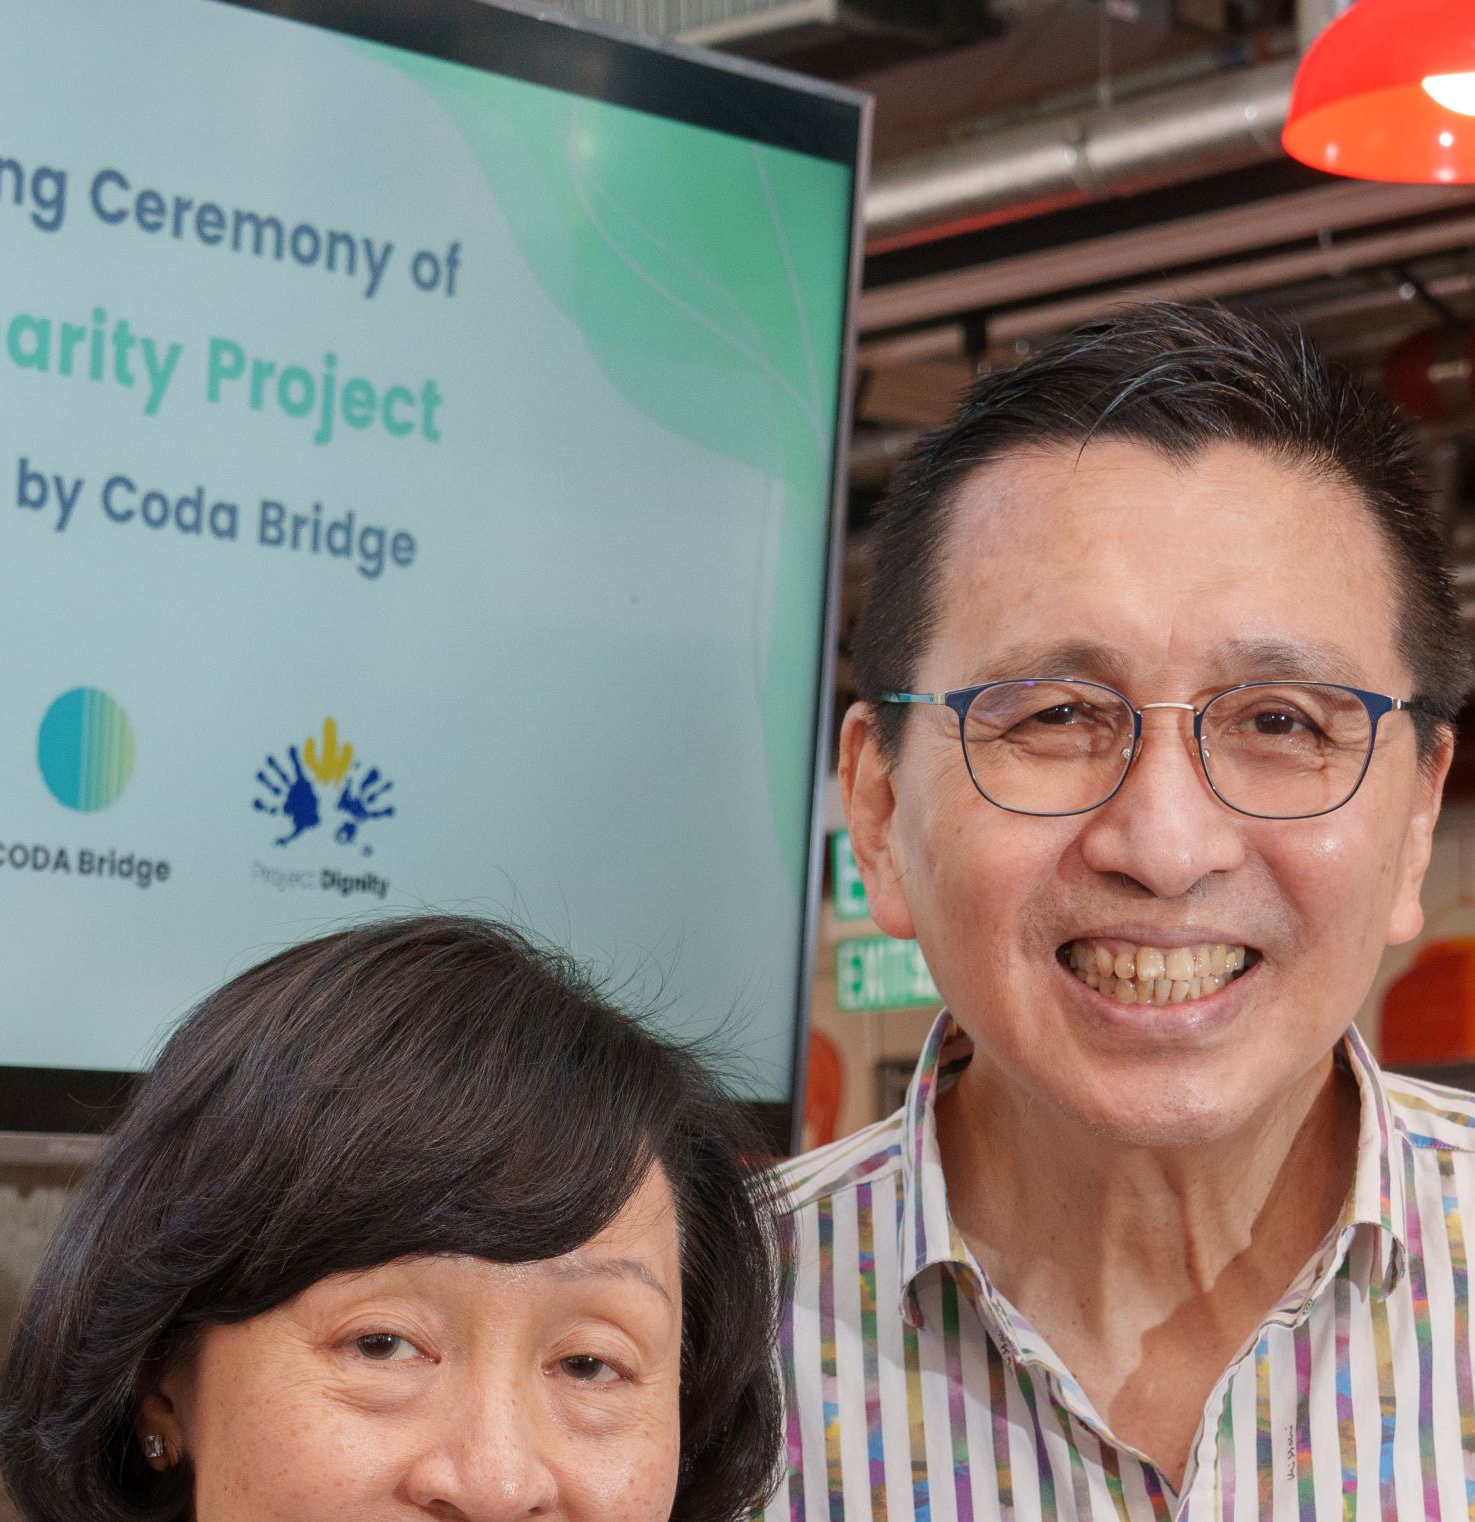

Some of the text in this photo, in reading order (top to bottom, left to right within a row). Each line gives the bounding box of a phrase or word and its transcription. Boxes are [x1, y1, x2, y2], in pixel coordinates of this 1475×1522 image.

[90, 168, 394, 299] Ceremony
[411, 242, 462, 298] of
[207, 337, 442, 446] Project
[16, 458, 83, 532] by
[101, 475, 239, 540] Coda
[258, 502, 418, 580] Bridge
[77, 848, 172, 889] Bridge
[319, 868, 390, 900] Dignity
